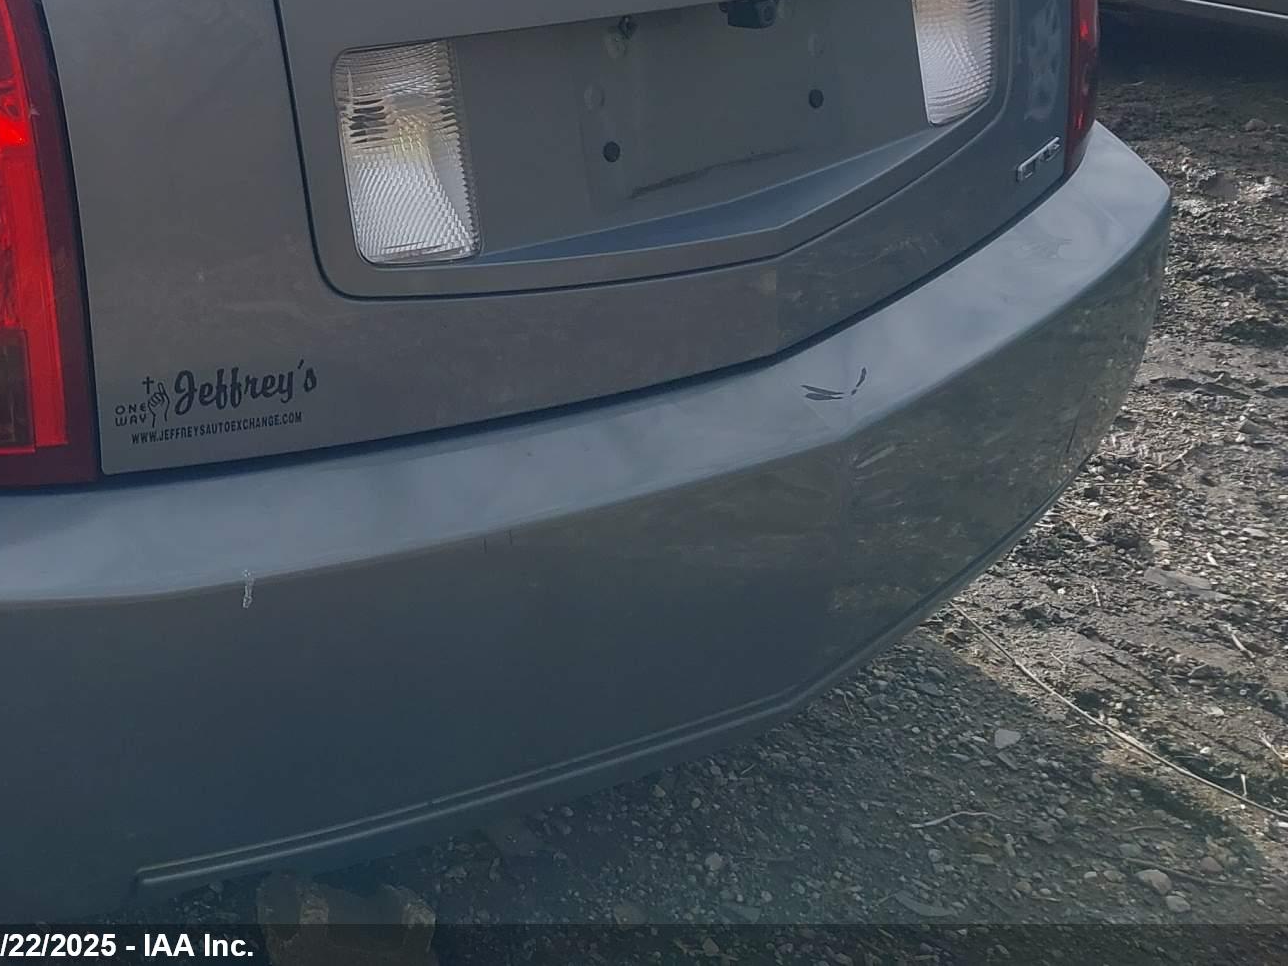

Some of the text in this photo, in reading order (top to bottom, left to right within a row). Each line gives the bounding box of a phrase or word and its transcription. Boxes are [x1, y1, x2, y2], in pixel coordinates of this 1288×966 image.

[173, 359, 318, 416] Jeffrey's
[115, 403, 147, 415] ONE
[115, 414, 147, 427] WAY
[131, 411, 303, 445] WWW.JEFFREYSAUTOEXCHANGE.COM
